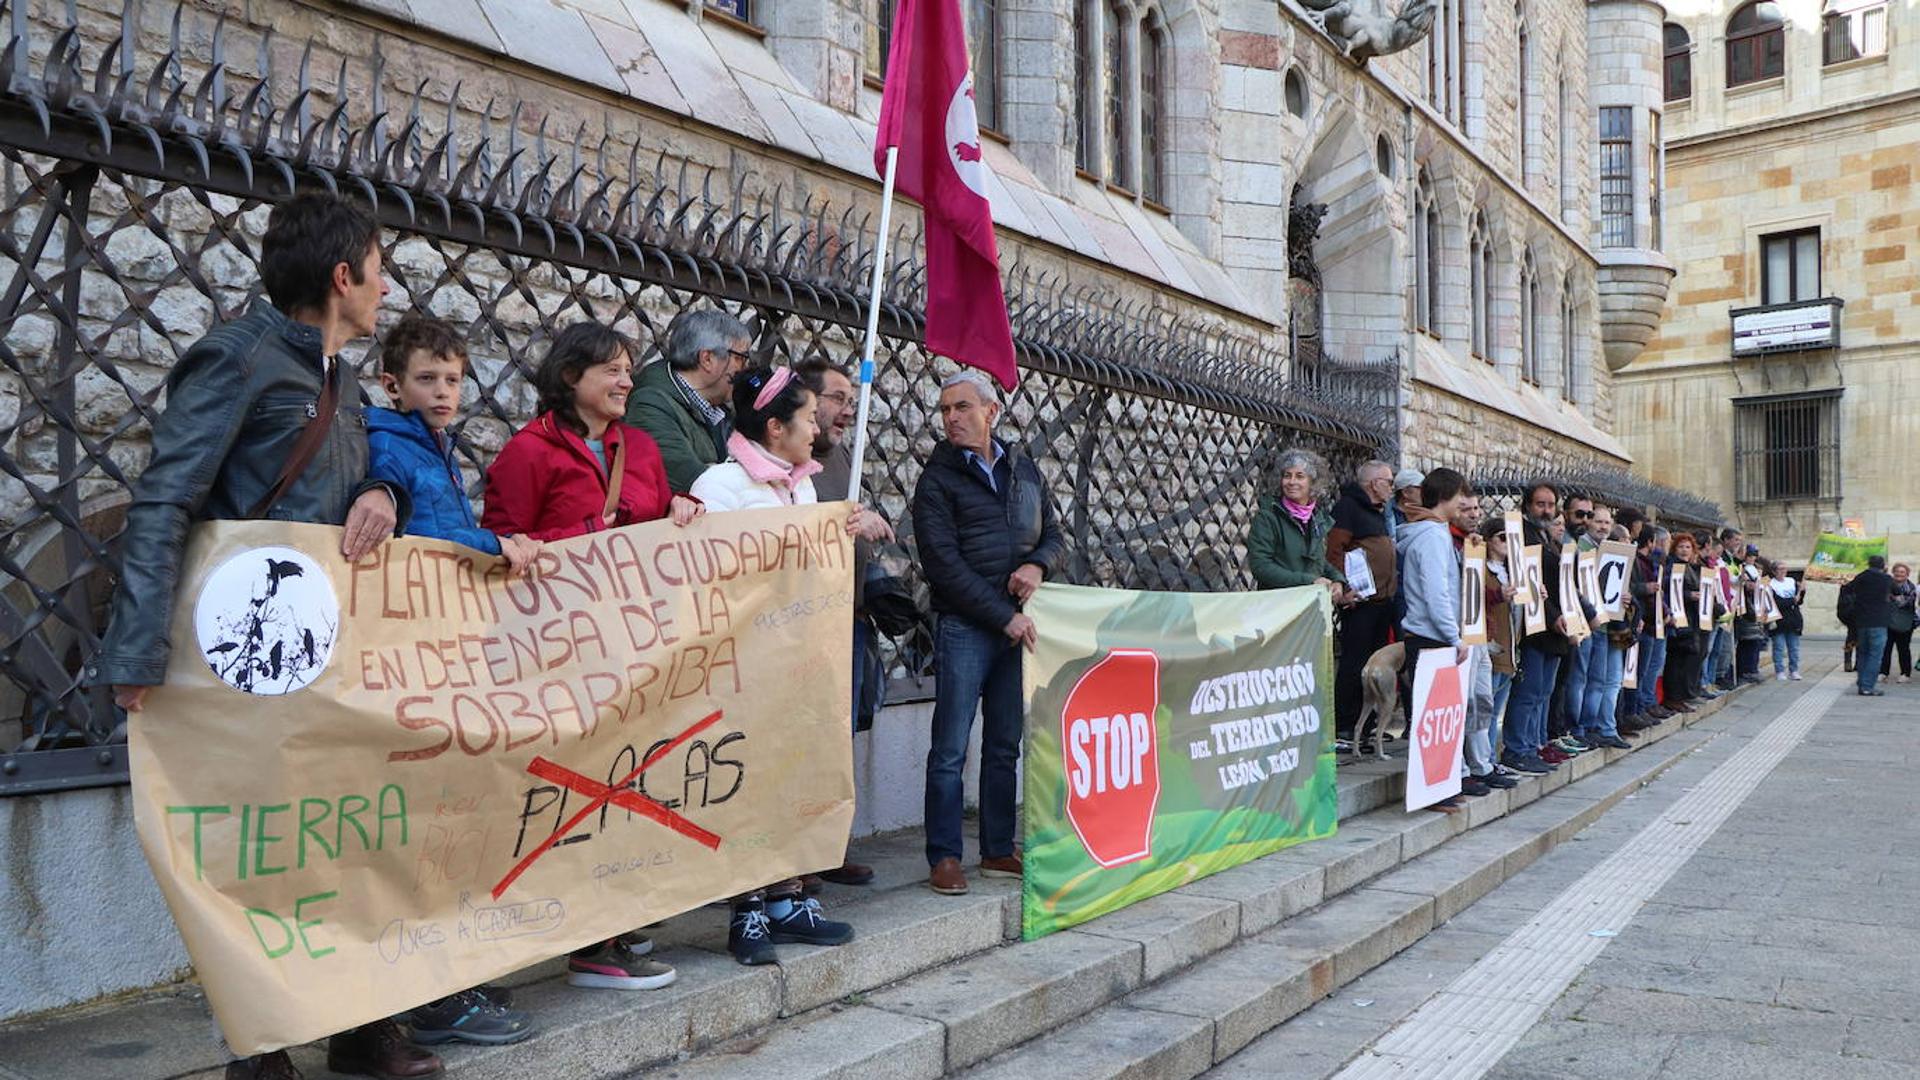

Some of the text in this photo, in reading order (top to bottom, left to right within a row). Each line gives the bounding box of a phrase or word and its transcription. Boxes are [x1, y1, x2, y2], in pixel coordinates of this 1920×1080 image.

[350, 518, 846, 623] PLATAFORMA CIUDADANA
[361, 587, 730, 691] EN DEFENSA DE LA
[387, 637, 741, 762] SOBARRIBA
[1190, 657, 1315, 715] DESTRUCCIÓN
[1421, 703, 1461, 748] STOP
[514, 731, 746, 858] PLACAS
[1070, 712, 1150, 799] STOP
[1190, 740, 1212, 760] DEL
[165, 784, 408, 881] TIERRA
[243, 890, 338, 960] DE
